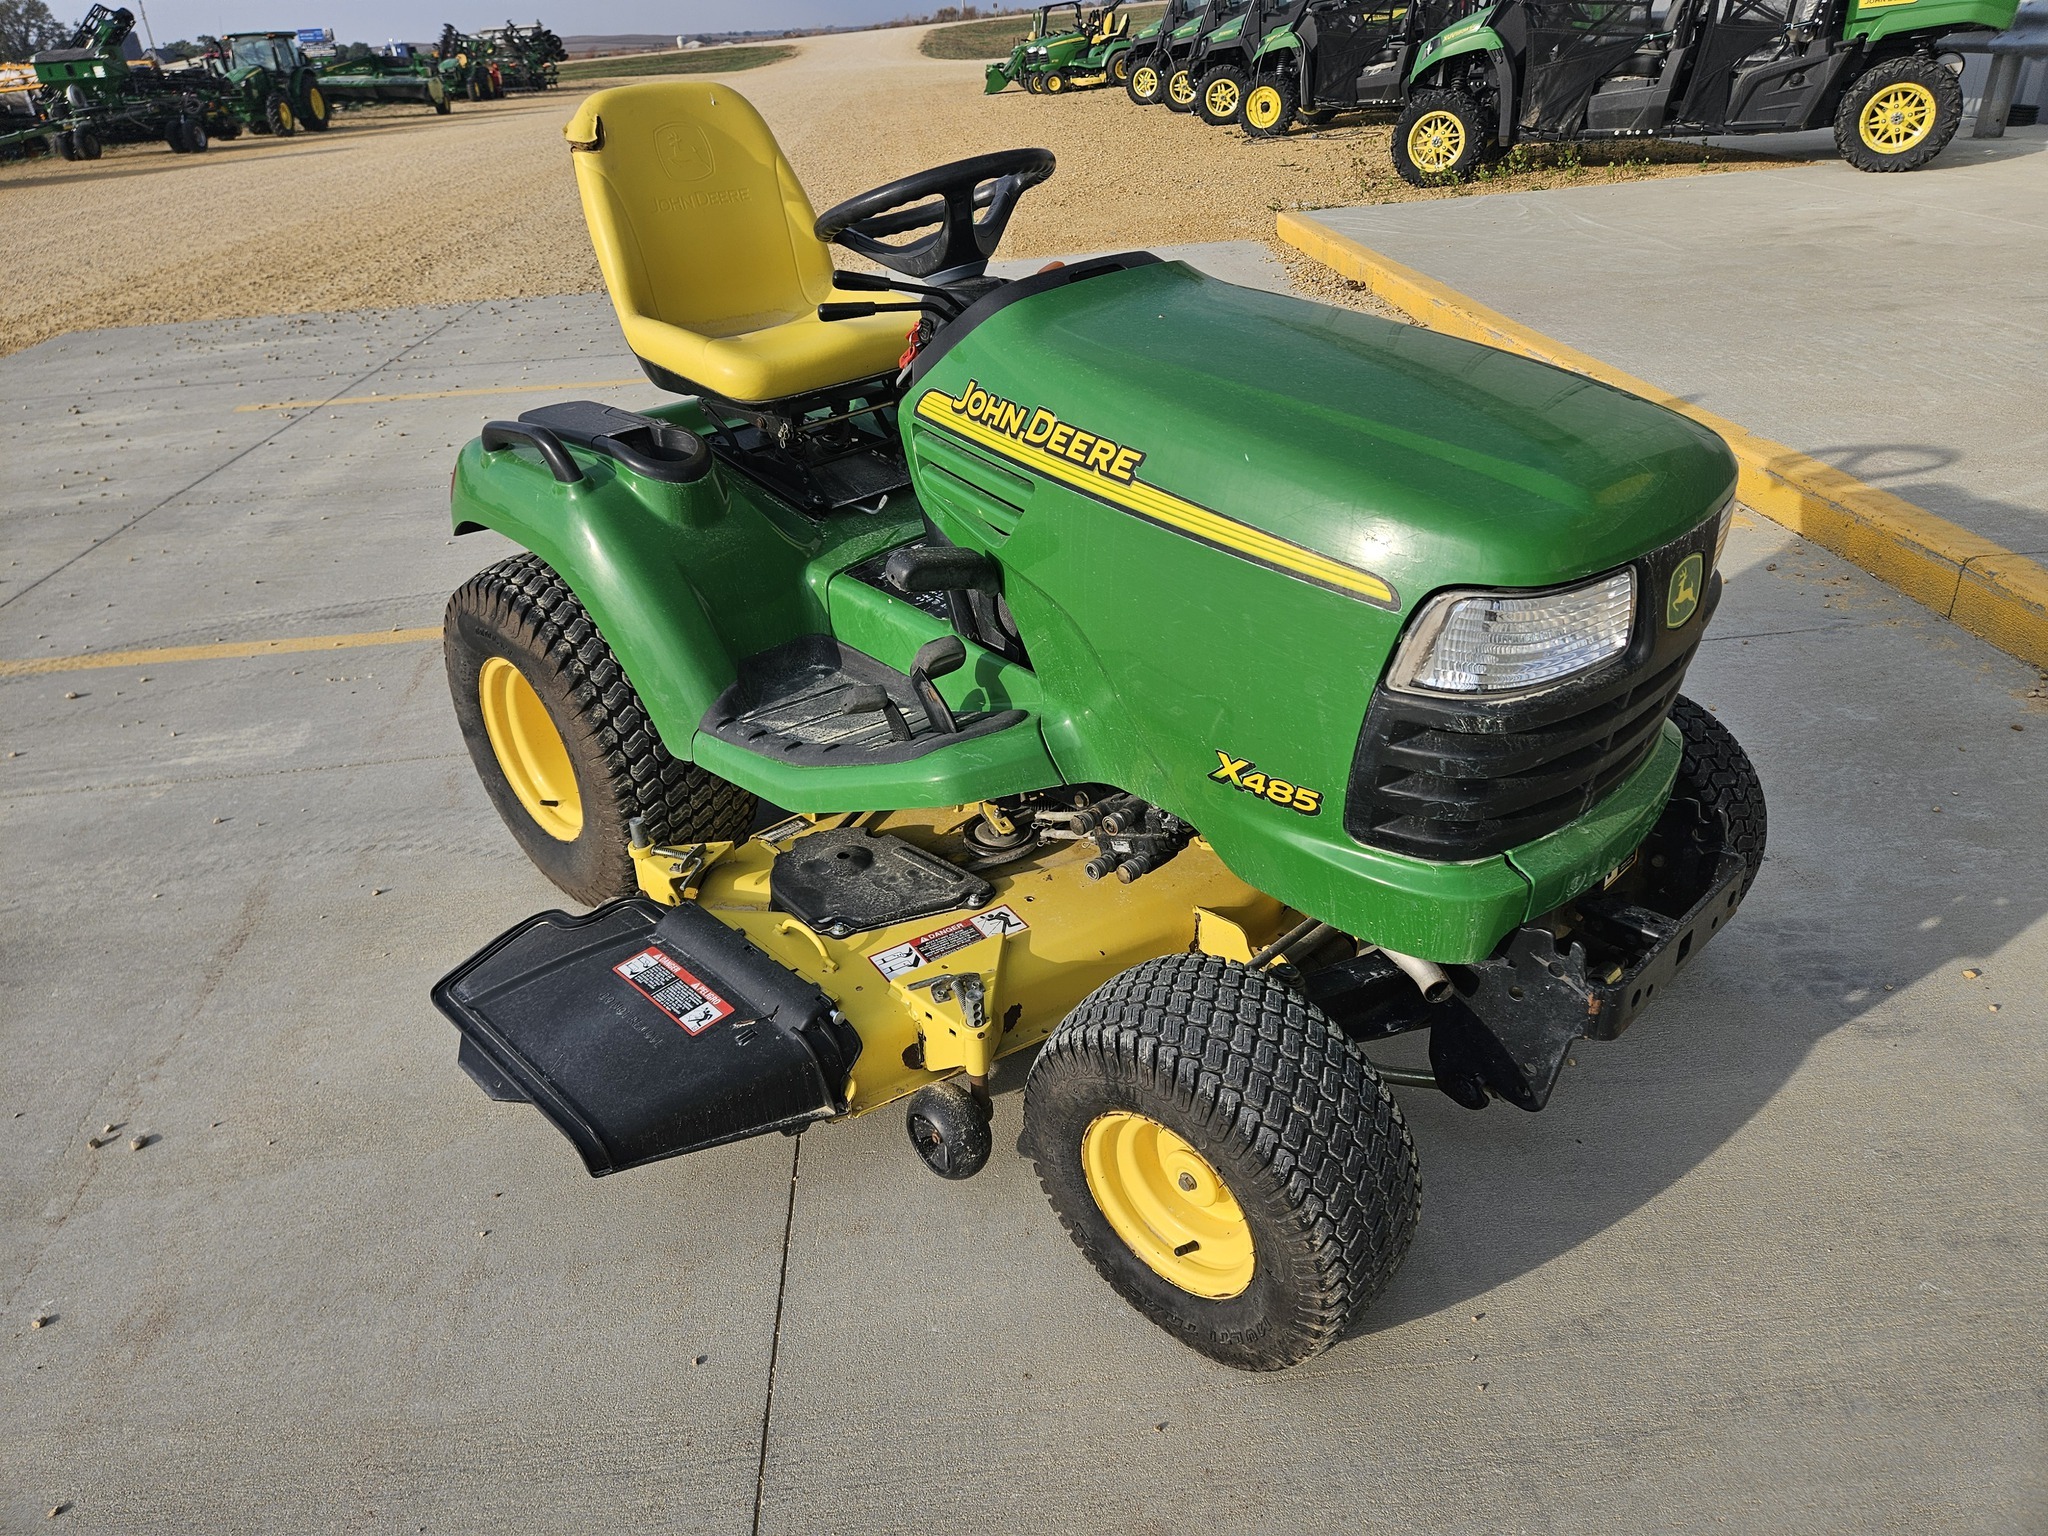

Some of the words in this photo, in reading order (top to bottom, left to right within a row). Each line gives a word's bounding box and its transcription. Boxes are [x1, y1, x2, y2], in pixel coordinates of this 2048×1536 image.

[652, 195, 695, 213] JOHN
[694, 188, 752, 206] DEERE
[951, 379, 1030, 438] JOHN
[1023, 406, 1147, 486] DEERE
[1207, 749, 1325, 816] X485
[928, 922, 964, 939] DANGER
[659, 955, 681, 973] DANGER
[698, 985, 721, 1005] PELIGRO
[1208, 1316, 1272, 1345] MULTI
